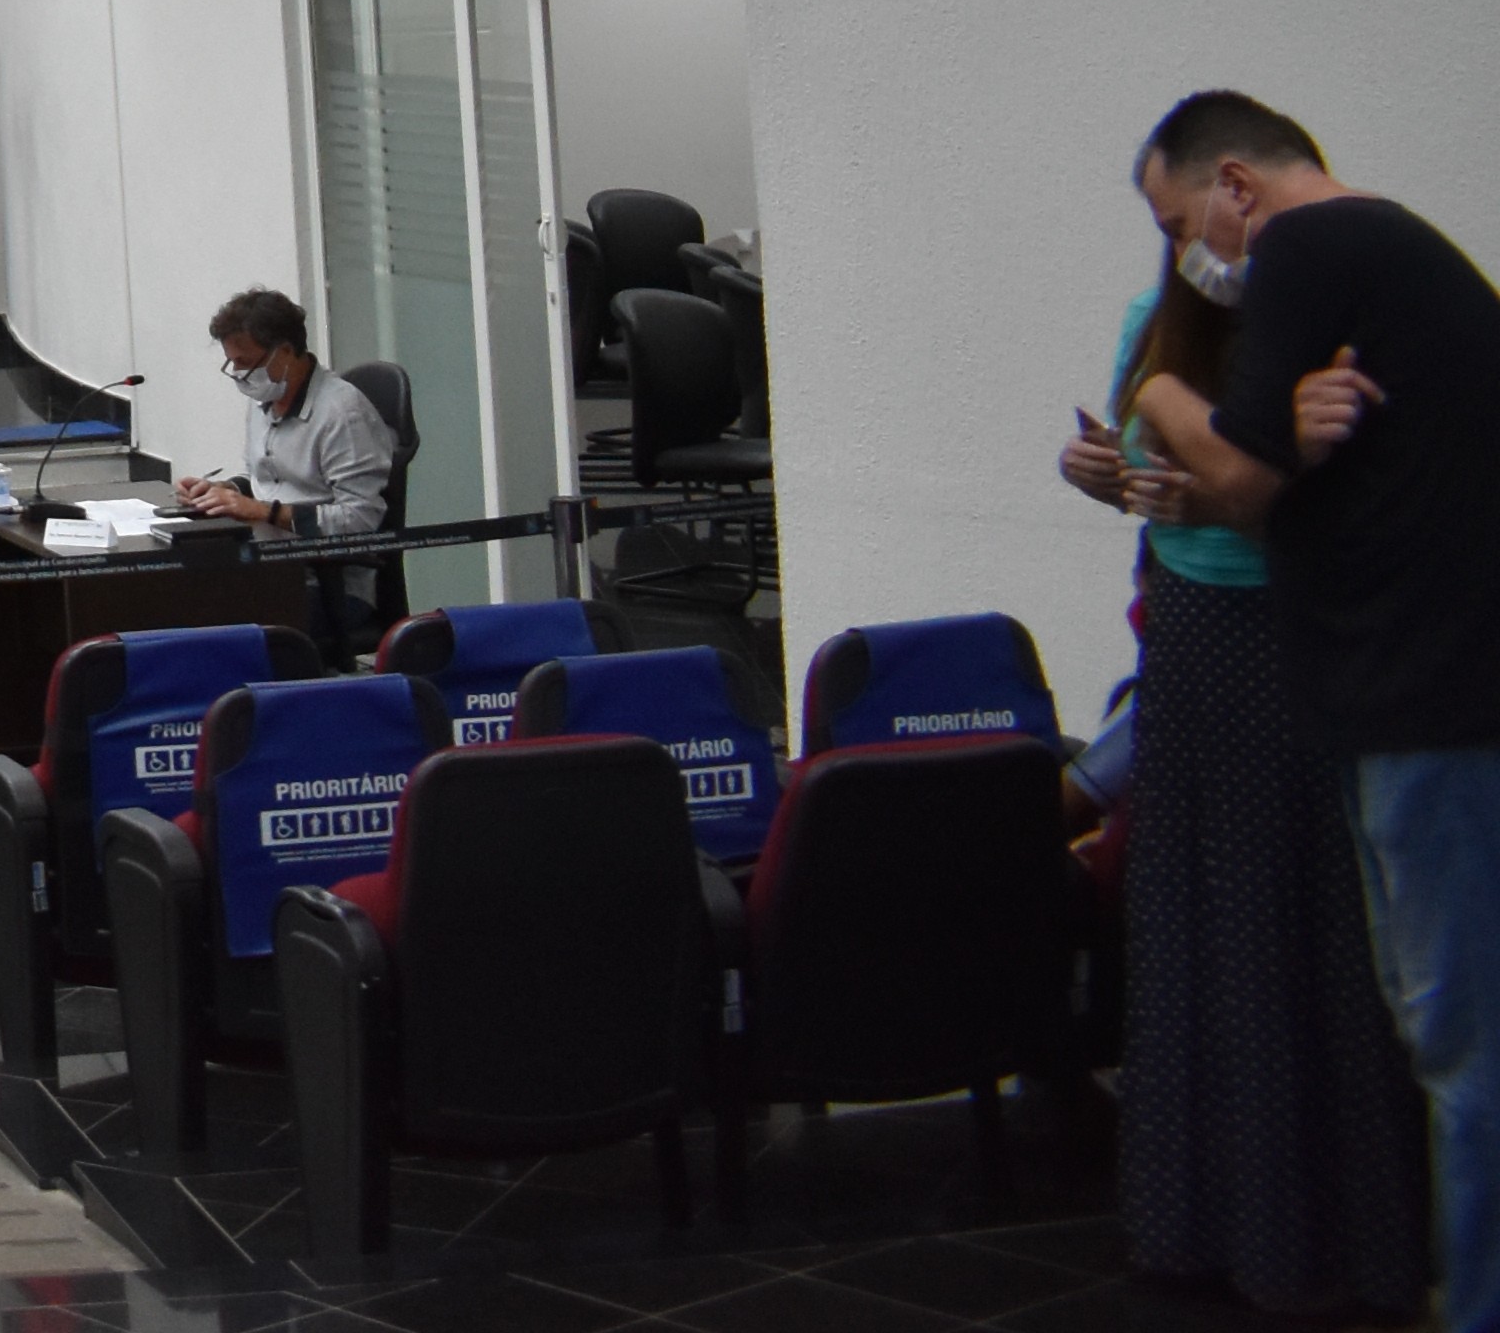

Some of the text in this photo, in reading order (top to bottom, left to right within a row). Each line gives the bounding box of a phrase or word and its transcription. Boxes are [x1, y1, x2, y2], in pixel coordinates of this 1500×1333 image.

[894, 708, 1014, 735] PRIORITÁRIO
[669, 737, 735, 761] ITÁRIO
[275, 772, 409, 801] PRIORITÁRIO
